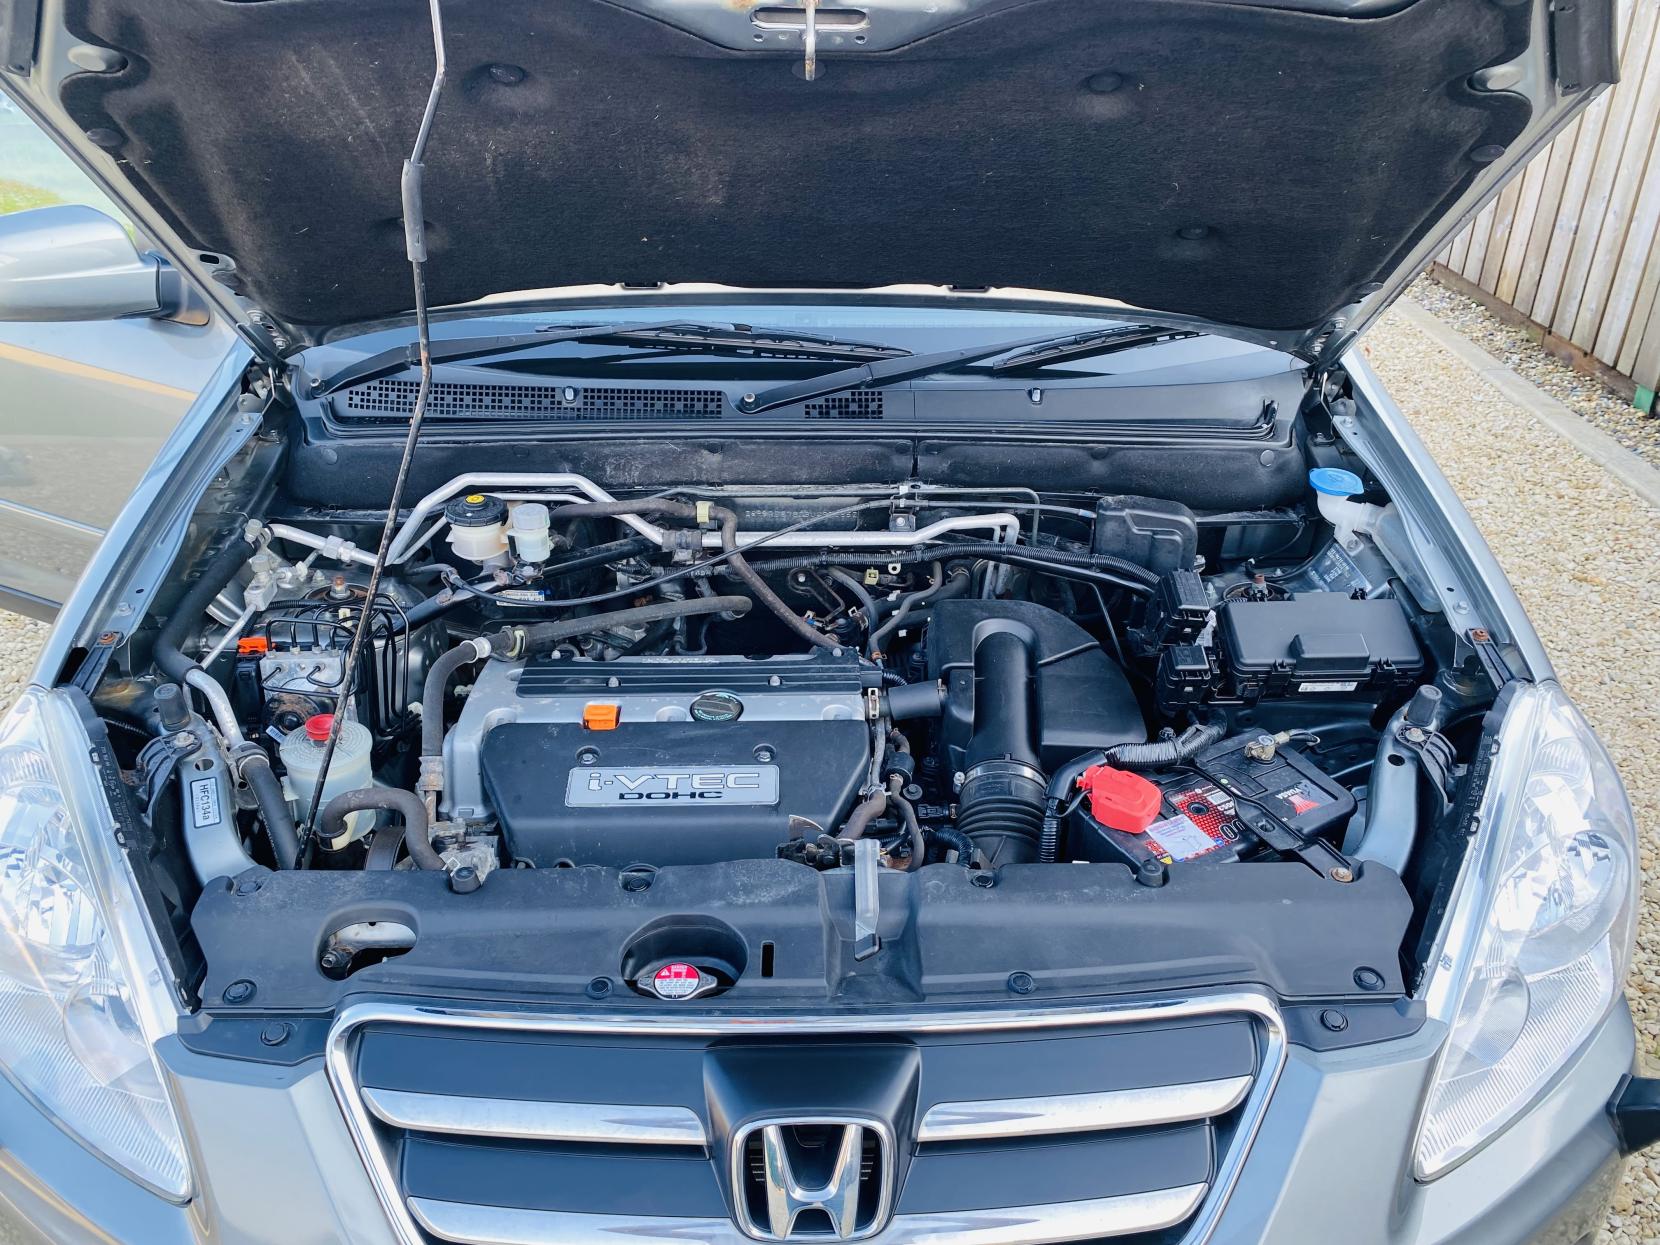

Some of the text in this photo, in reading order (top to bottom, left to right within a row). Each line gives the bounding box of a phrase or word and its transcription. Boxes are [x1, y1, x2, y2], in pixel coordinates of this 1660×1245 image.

[588, 772, 760, 791] i-VTEC
[199, 783, 212, 821] HFC134a
[618, 791, 723, 800] DOHC
